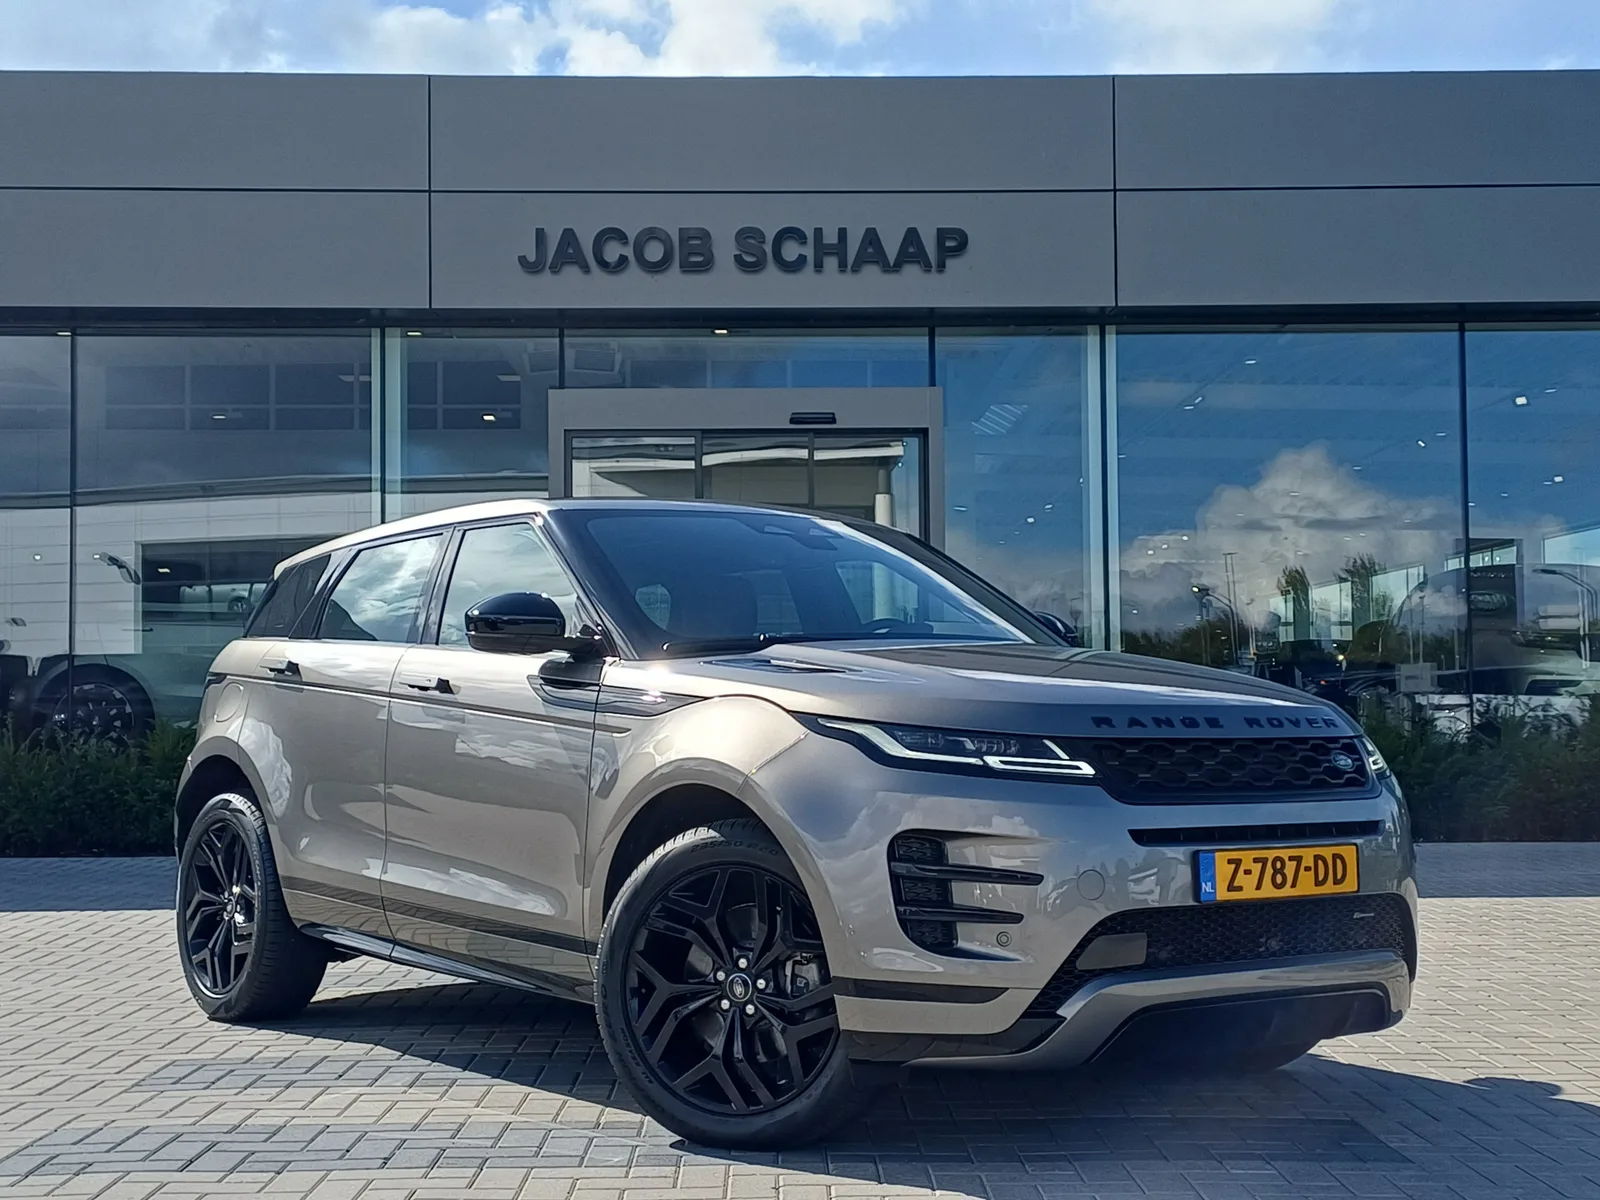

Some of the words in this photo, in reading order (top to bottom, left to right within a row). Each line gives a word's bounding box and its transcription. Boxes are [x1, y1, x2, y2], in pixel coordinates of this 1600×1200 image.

[518, 227, 714, 272] JACOB
[733, 226, 969, 273] SCHAAP
[1091, 715, 1225, 729] RANGE
[1243, 715, 1339, 729] ROVER
[1226, 853, 1348, 893] Z-787-DD
[1202, 882, 1215, 893] NL
